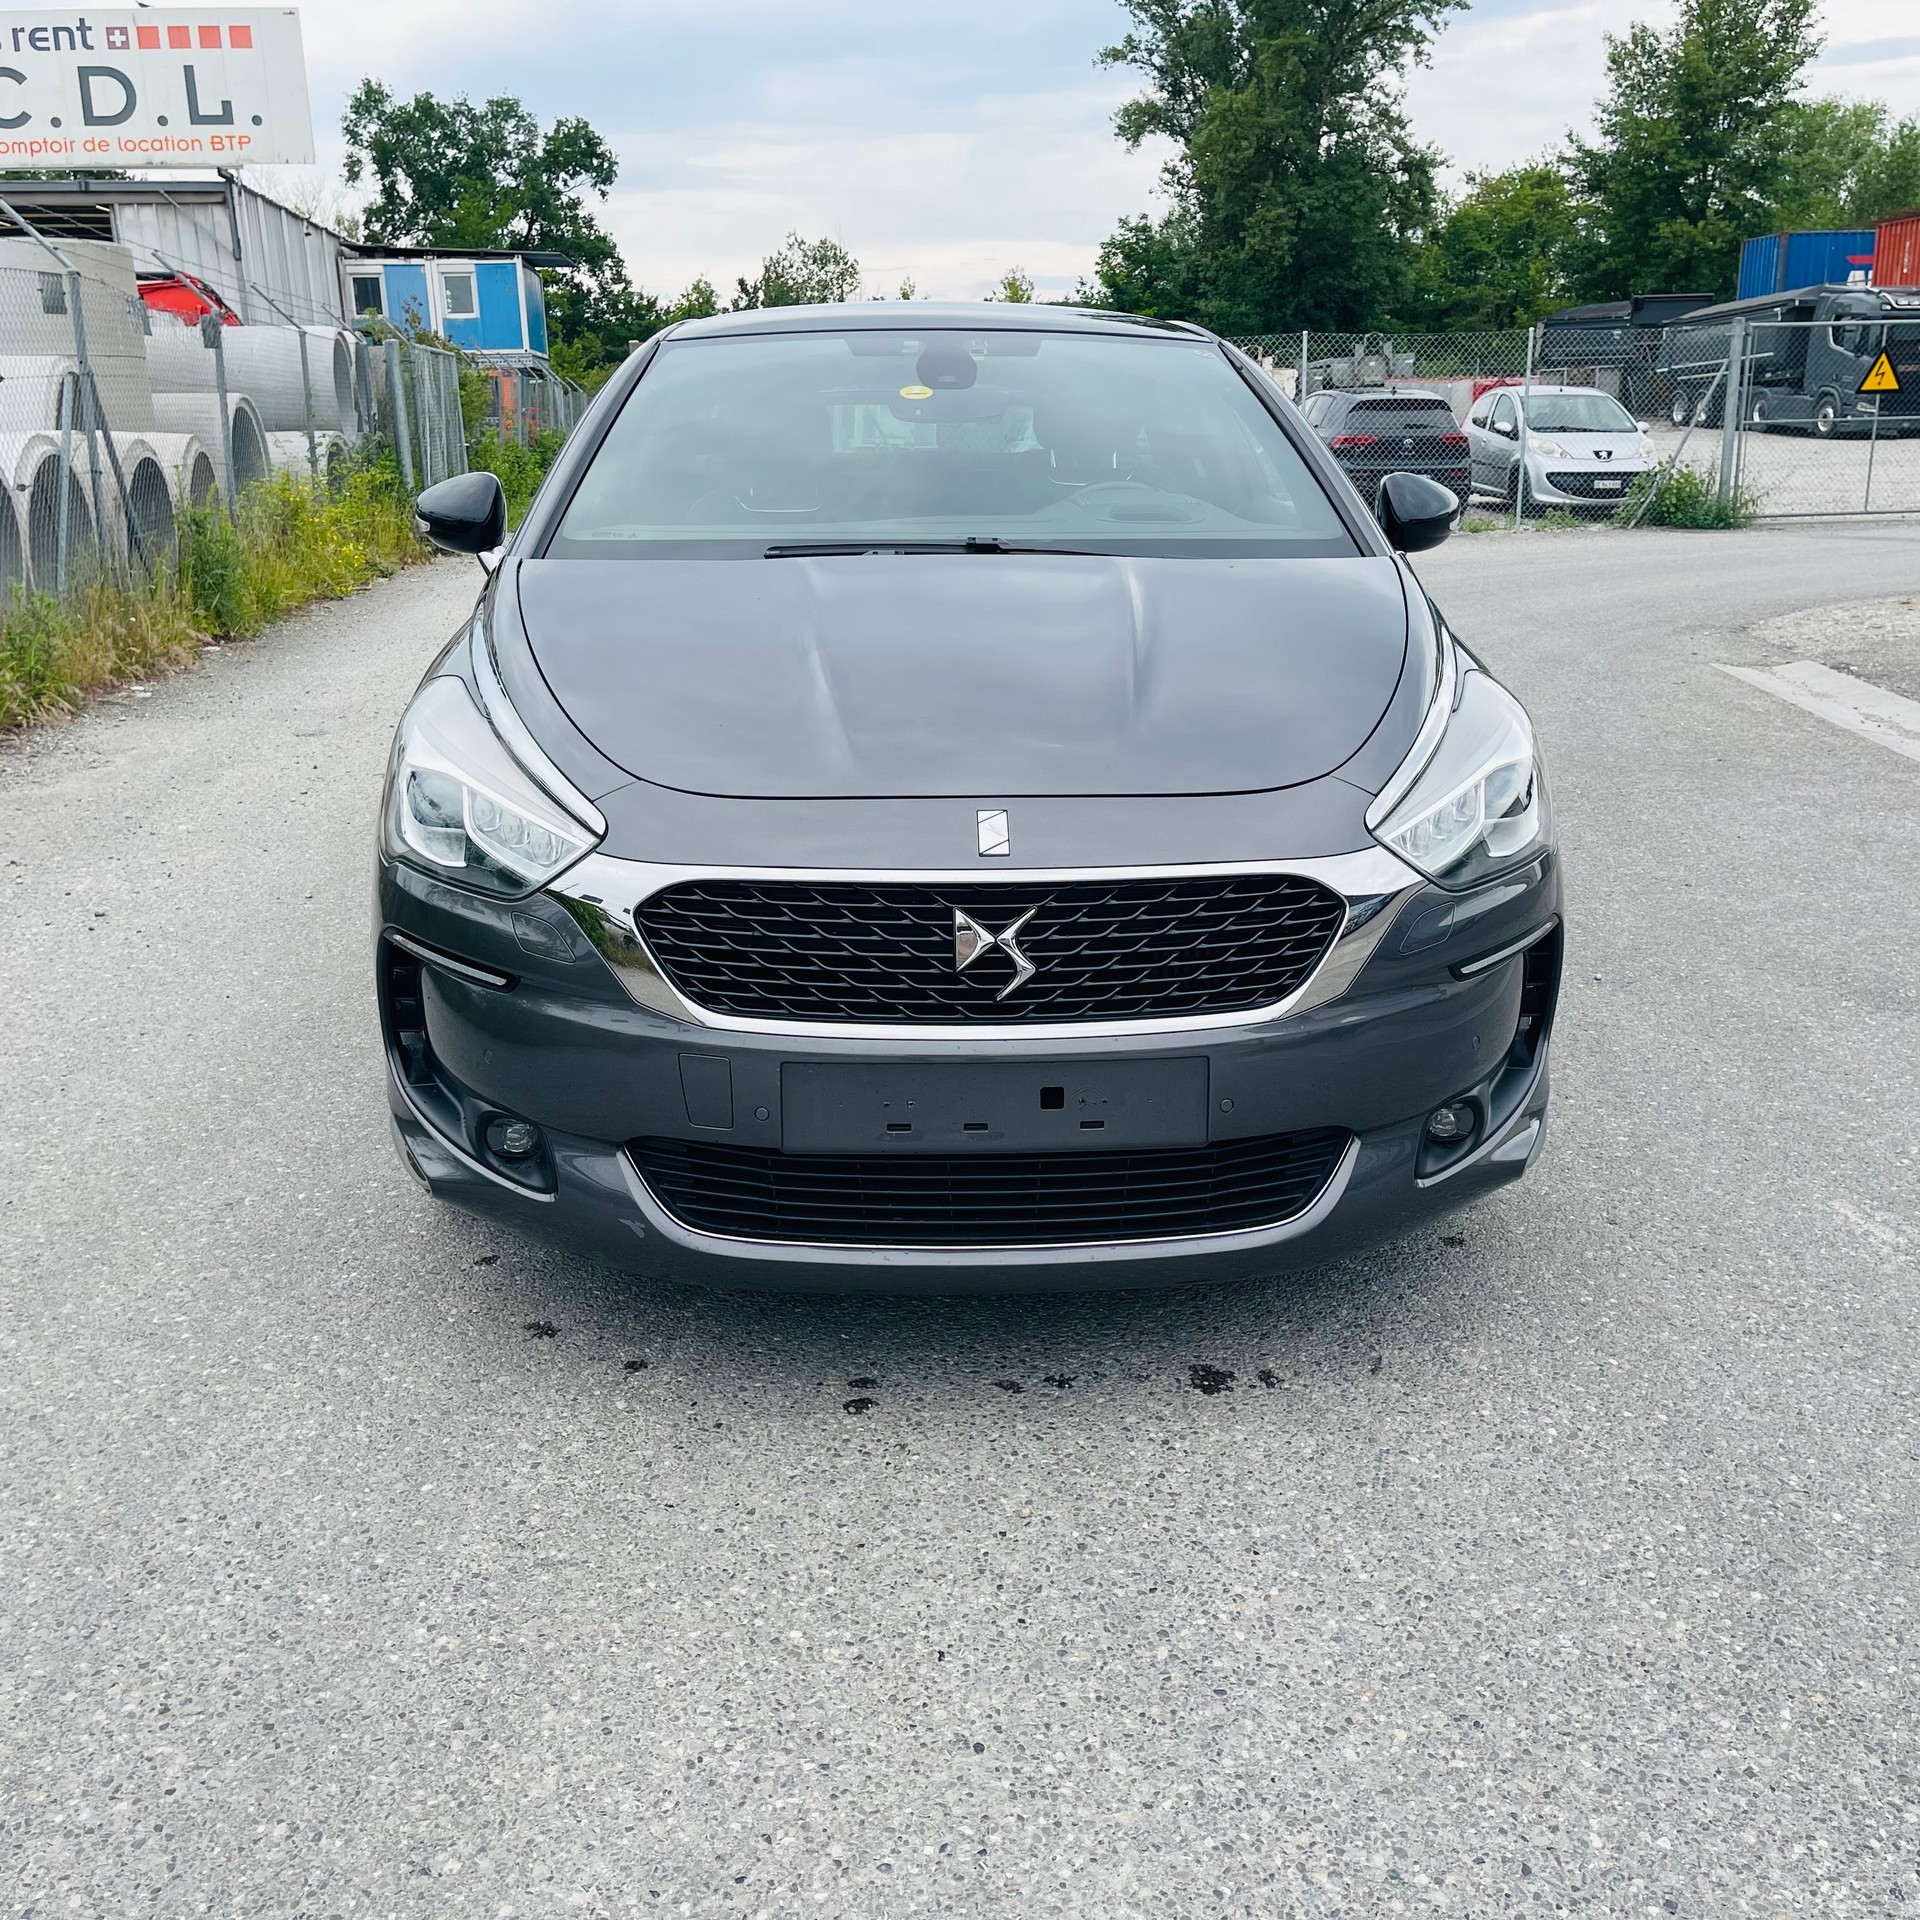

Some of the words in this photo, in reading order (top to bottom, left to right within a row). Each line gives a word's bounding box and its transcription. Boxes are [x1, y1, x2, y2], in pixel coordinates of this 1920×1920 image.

[12, 18, 94, 52] rent
[83, 137, 110, 152] de
[117, 136, 203, 153] location
[210, 135, 251, 151] BTP
